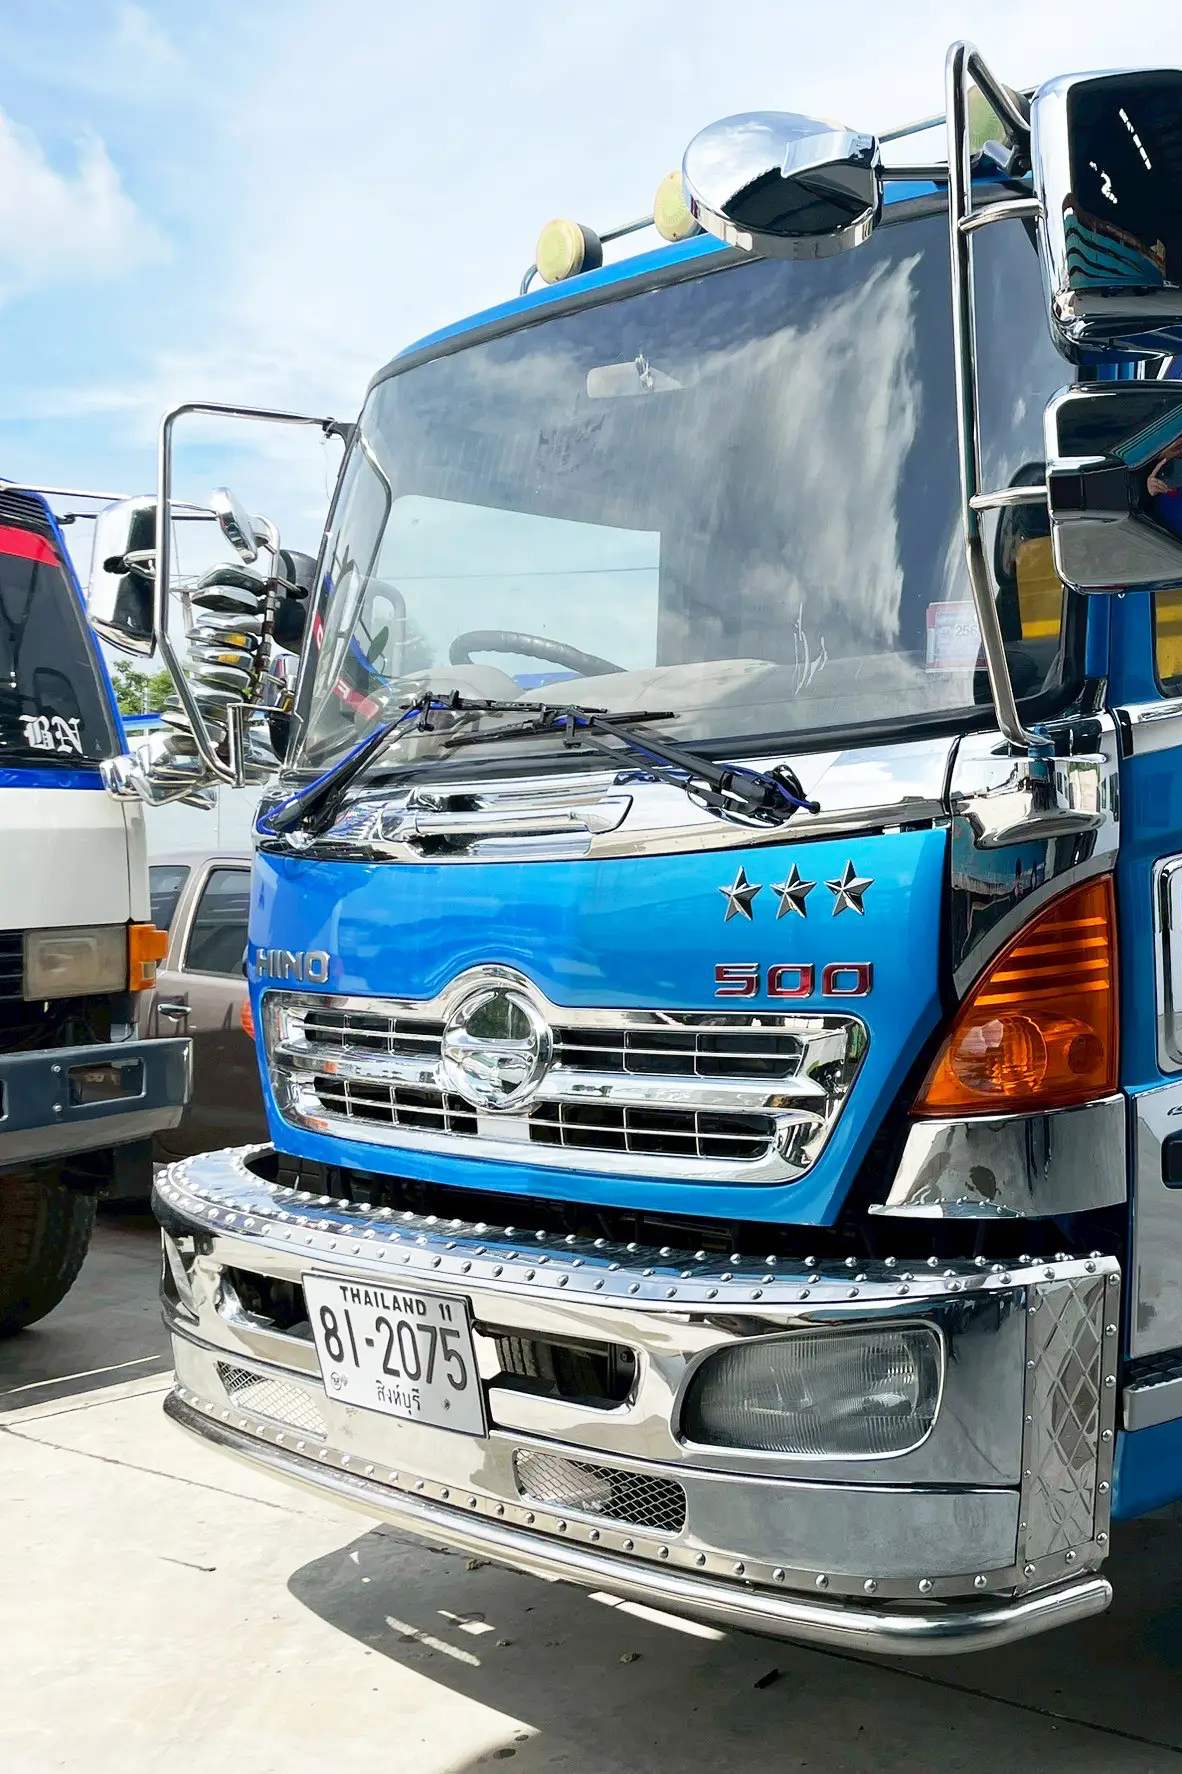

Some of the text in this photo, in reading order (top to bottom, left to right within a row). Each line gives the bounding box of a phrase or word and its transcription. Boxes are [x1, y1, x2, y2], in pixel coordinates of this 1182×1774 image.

[18, 714, 83, 754] BN
[256, 948, 330, 984] HINO
[714, 962, 874, 999] 500
[339, 1285, 453, 1322] THAILAND 11
[319, 1304, 468, 1391] 81-2075
[375, 1379, 421, 1416] สิงห์บุรี
